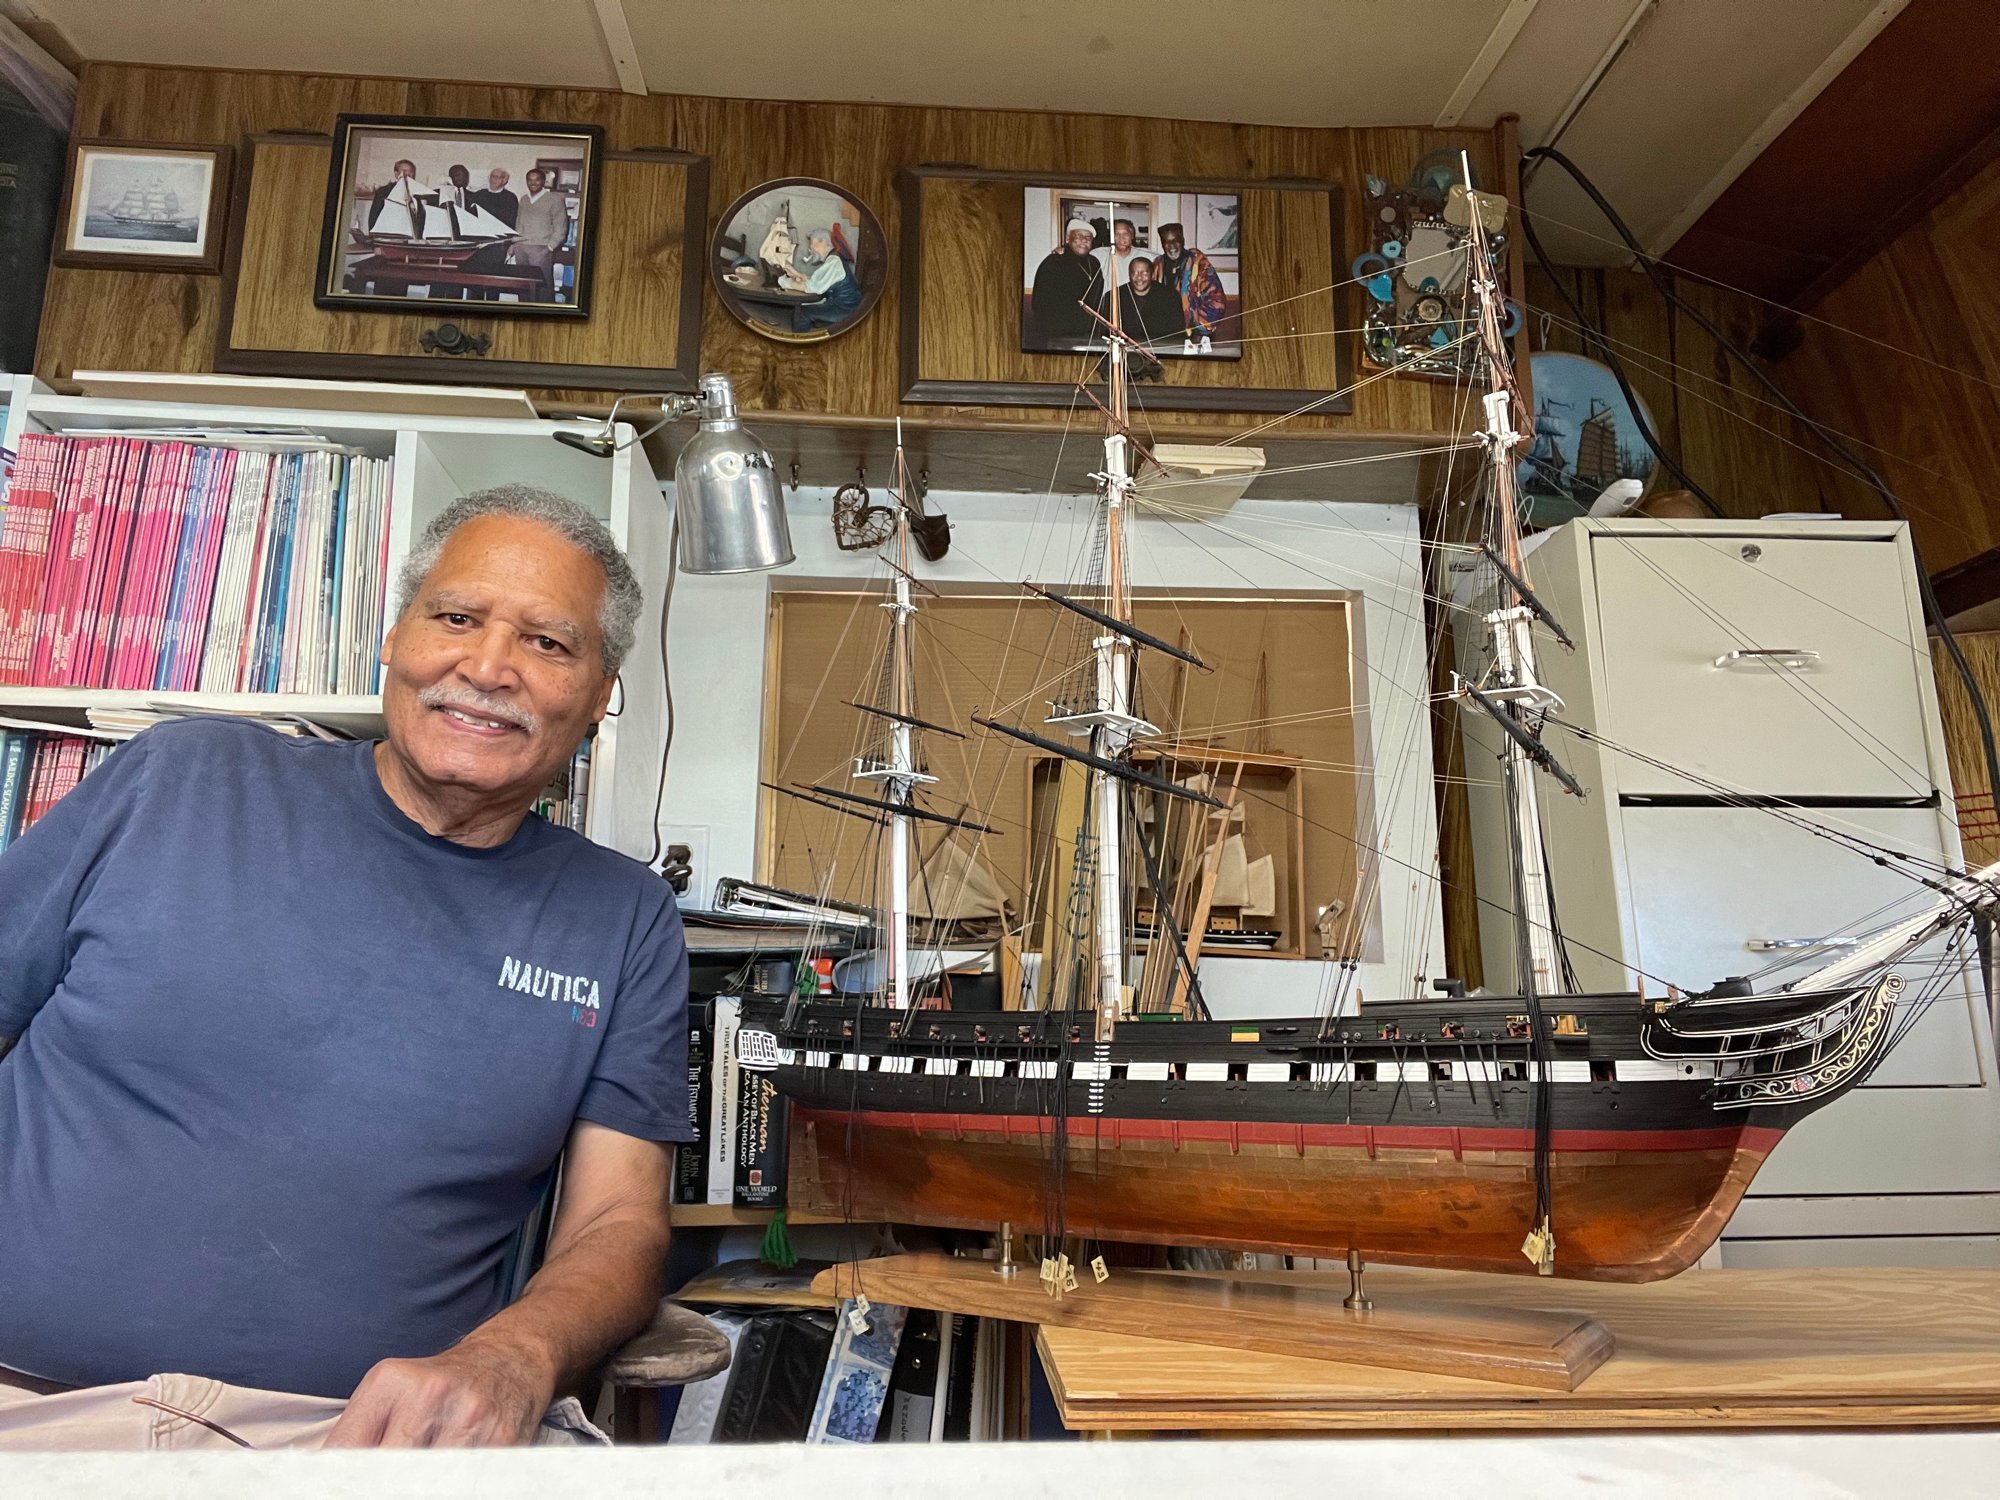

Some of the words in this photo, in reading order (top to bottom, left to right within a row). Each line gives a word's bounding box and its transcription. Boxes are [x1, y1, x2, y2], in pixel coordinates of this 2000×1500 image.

[498, 956, 600, 1010] NAUTICA
[688, 1066, 701, 1082] THE
[722, 1050, 730, 1078] TALES
[722, 1078, 728, 1088] OF
[688, 1082, 701, 1123] TESTAMENT
[740, 1108, 749, 1168] ANTHOLOGY
[750, 1110, 758, 1141] BLACK
[680, 1146, 693, 1185] GRISHAM
[690, 1154, 702, 1177] JOHN
[748, 1142, 757, 1165] MEN
